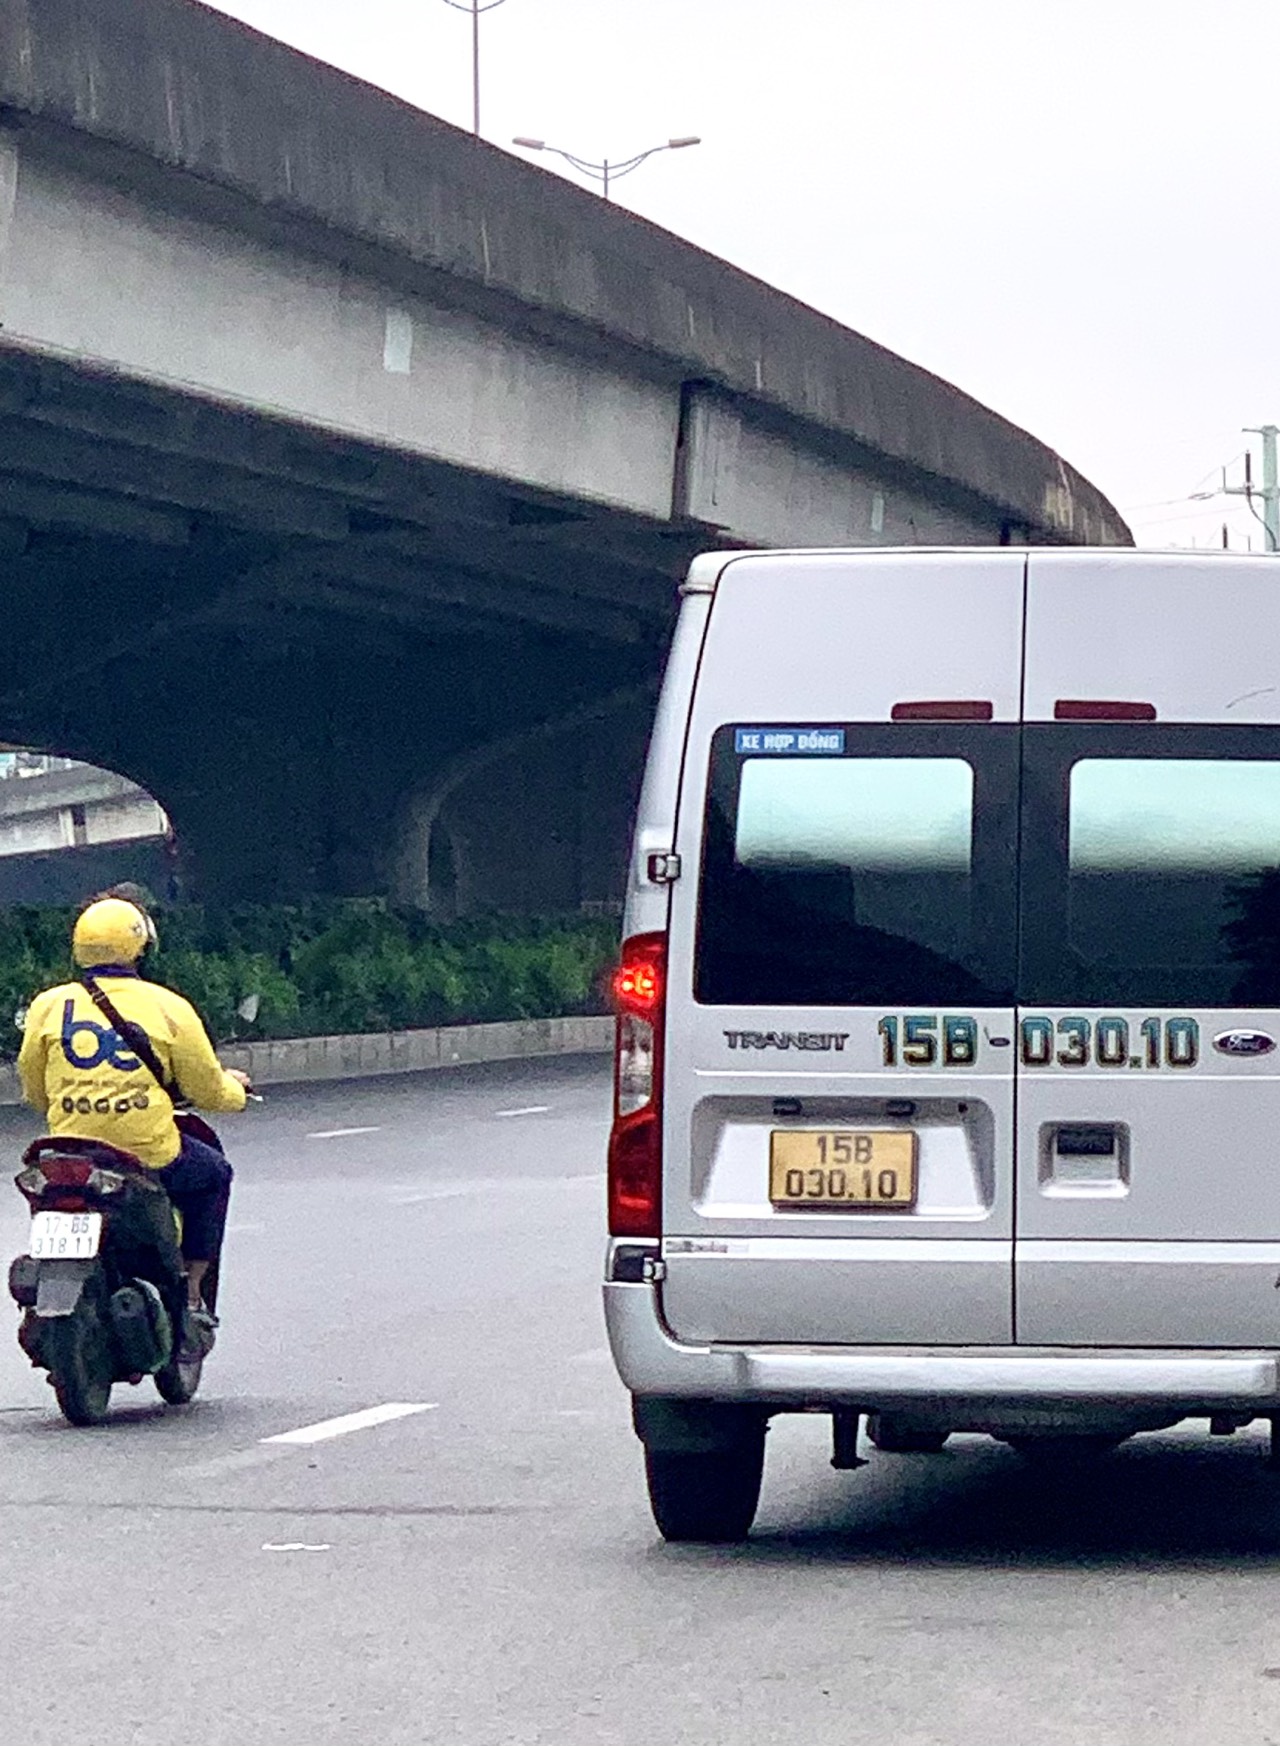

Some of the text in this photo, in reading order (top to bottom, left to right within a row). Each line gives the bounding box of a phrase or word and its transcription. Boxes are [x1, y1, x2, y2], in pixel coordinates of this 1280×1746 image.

[742, 734, 760, 749] XE
[62, 998, 142, 1071] be
[723, 1030, 849, 1051] TRANSIT
[817, 1135, 873, 1165] 15B
[785, 1168, 897, 1199] 030.10
